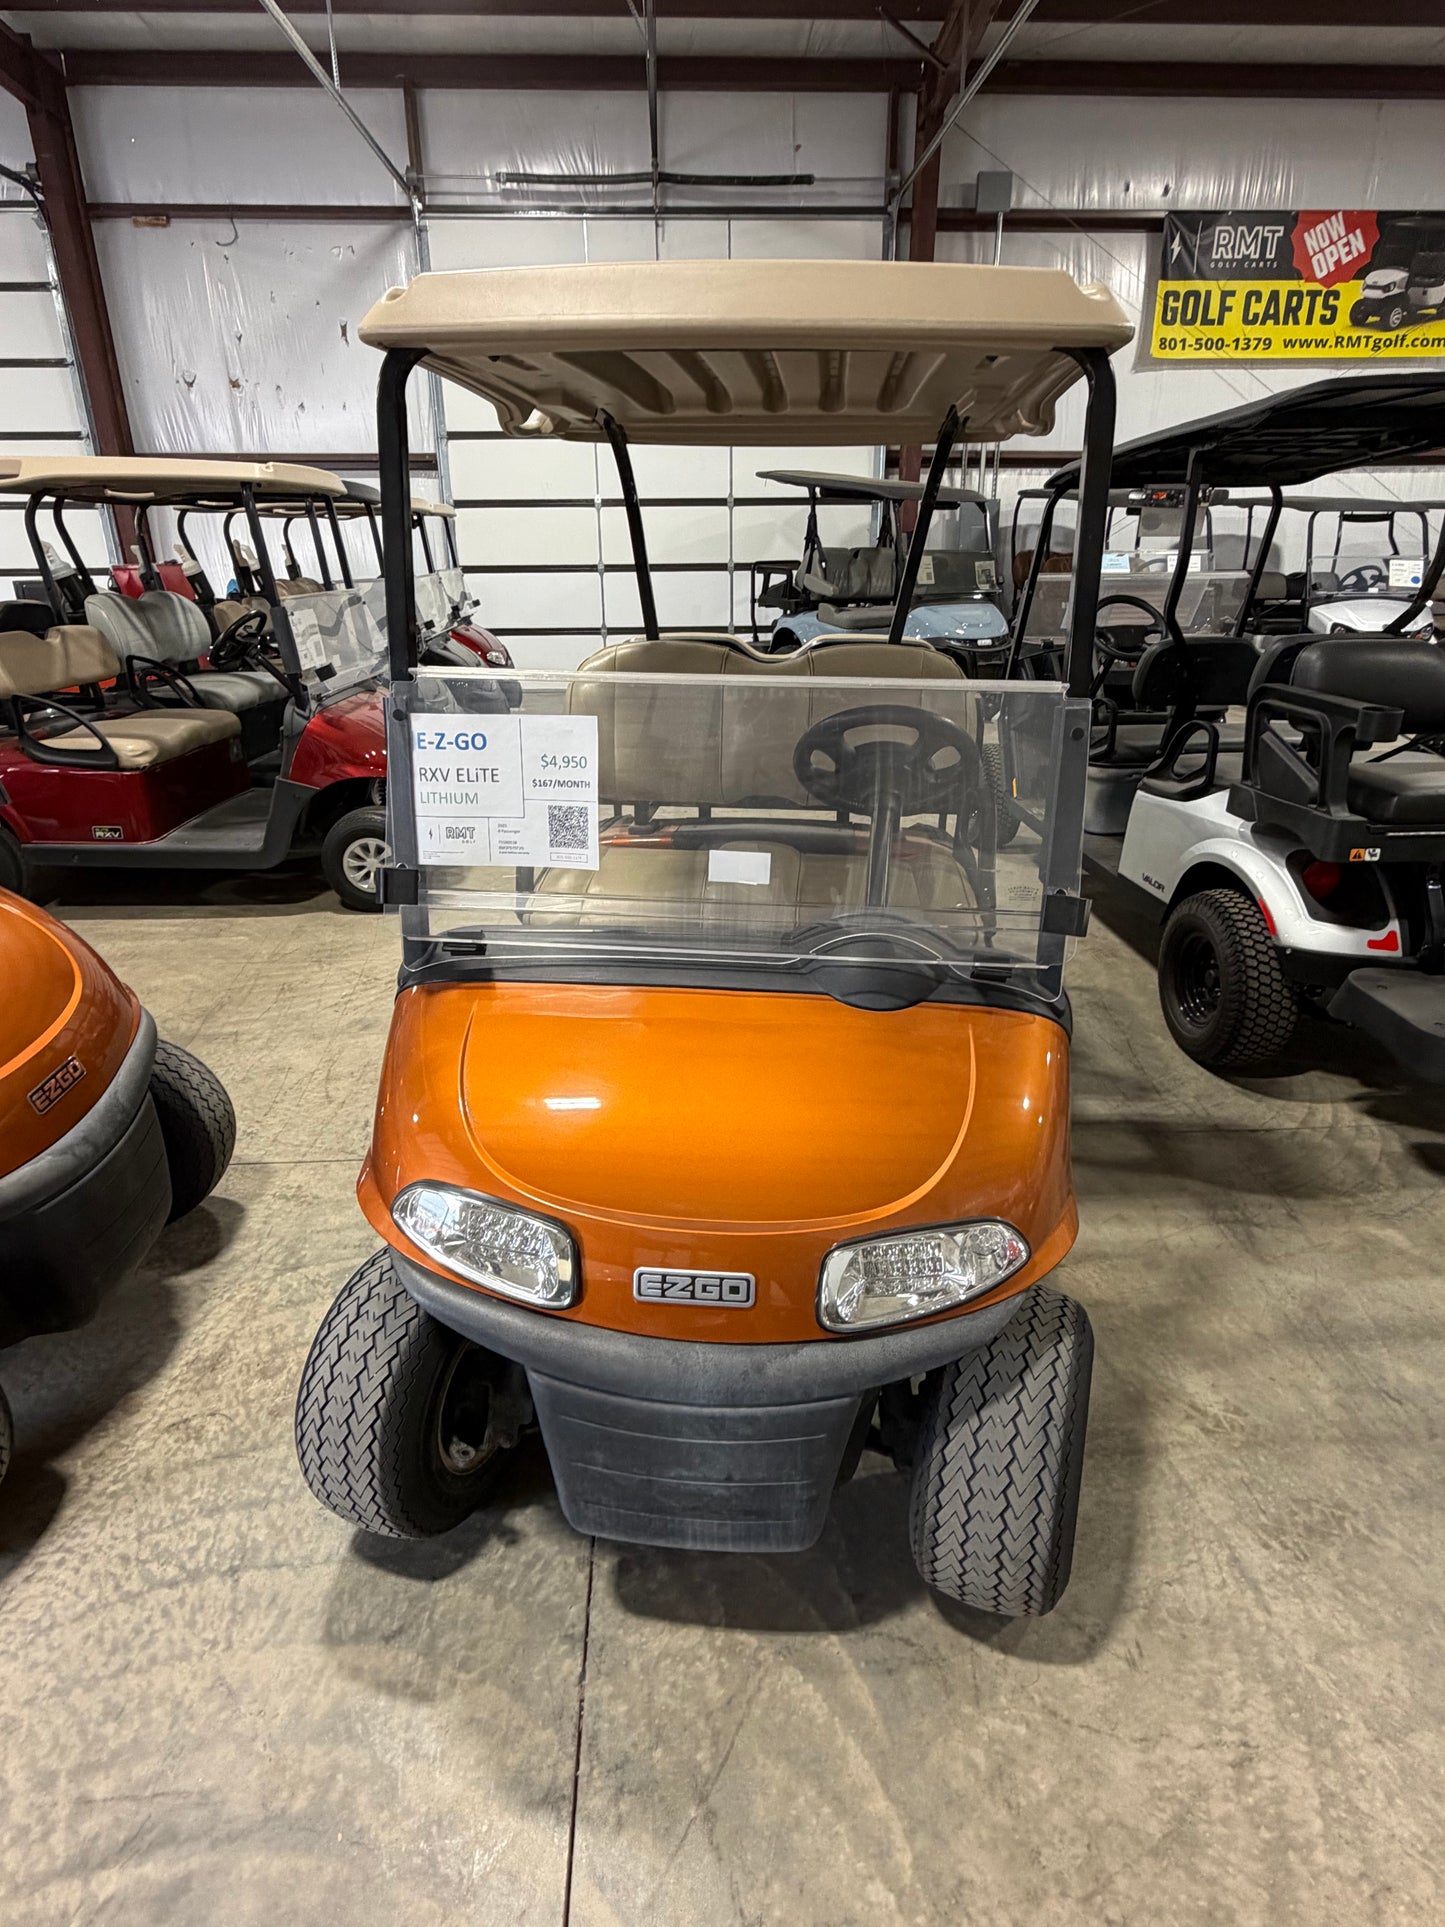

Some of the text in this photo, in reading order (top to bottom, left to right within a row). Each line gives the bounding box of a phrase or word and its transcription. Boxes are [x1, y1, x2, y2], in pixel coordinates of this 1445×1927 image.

[1211, 225, 1285, 259] RMT
[1303, 211, 1346, 257] NOW
[1311, 229, 1367, 280] OPEN
[1210, 260, 1278, 269] GOLF CARTS
[1160, 289, 1341, 326] GOLF CARTS
[1158, 334, 1445, 352] 801-500-1379 www.RMTgolf.com
[416, 732, 488, 751] E-Z-GO
[540, 753, 588, 771] $4,950
[419, 767, 451, 783] RXV
[532, 779, 591, 789] $167/MONTH
[420, 792, 479, 805] LITHIUM
[445, 826, 476, 840] RMT
[1142, 872, 1165, 893] VALOR
